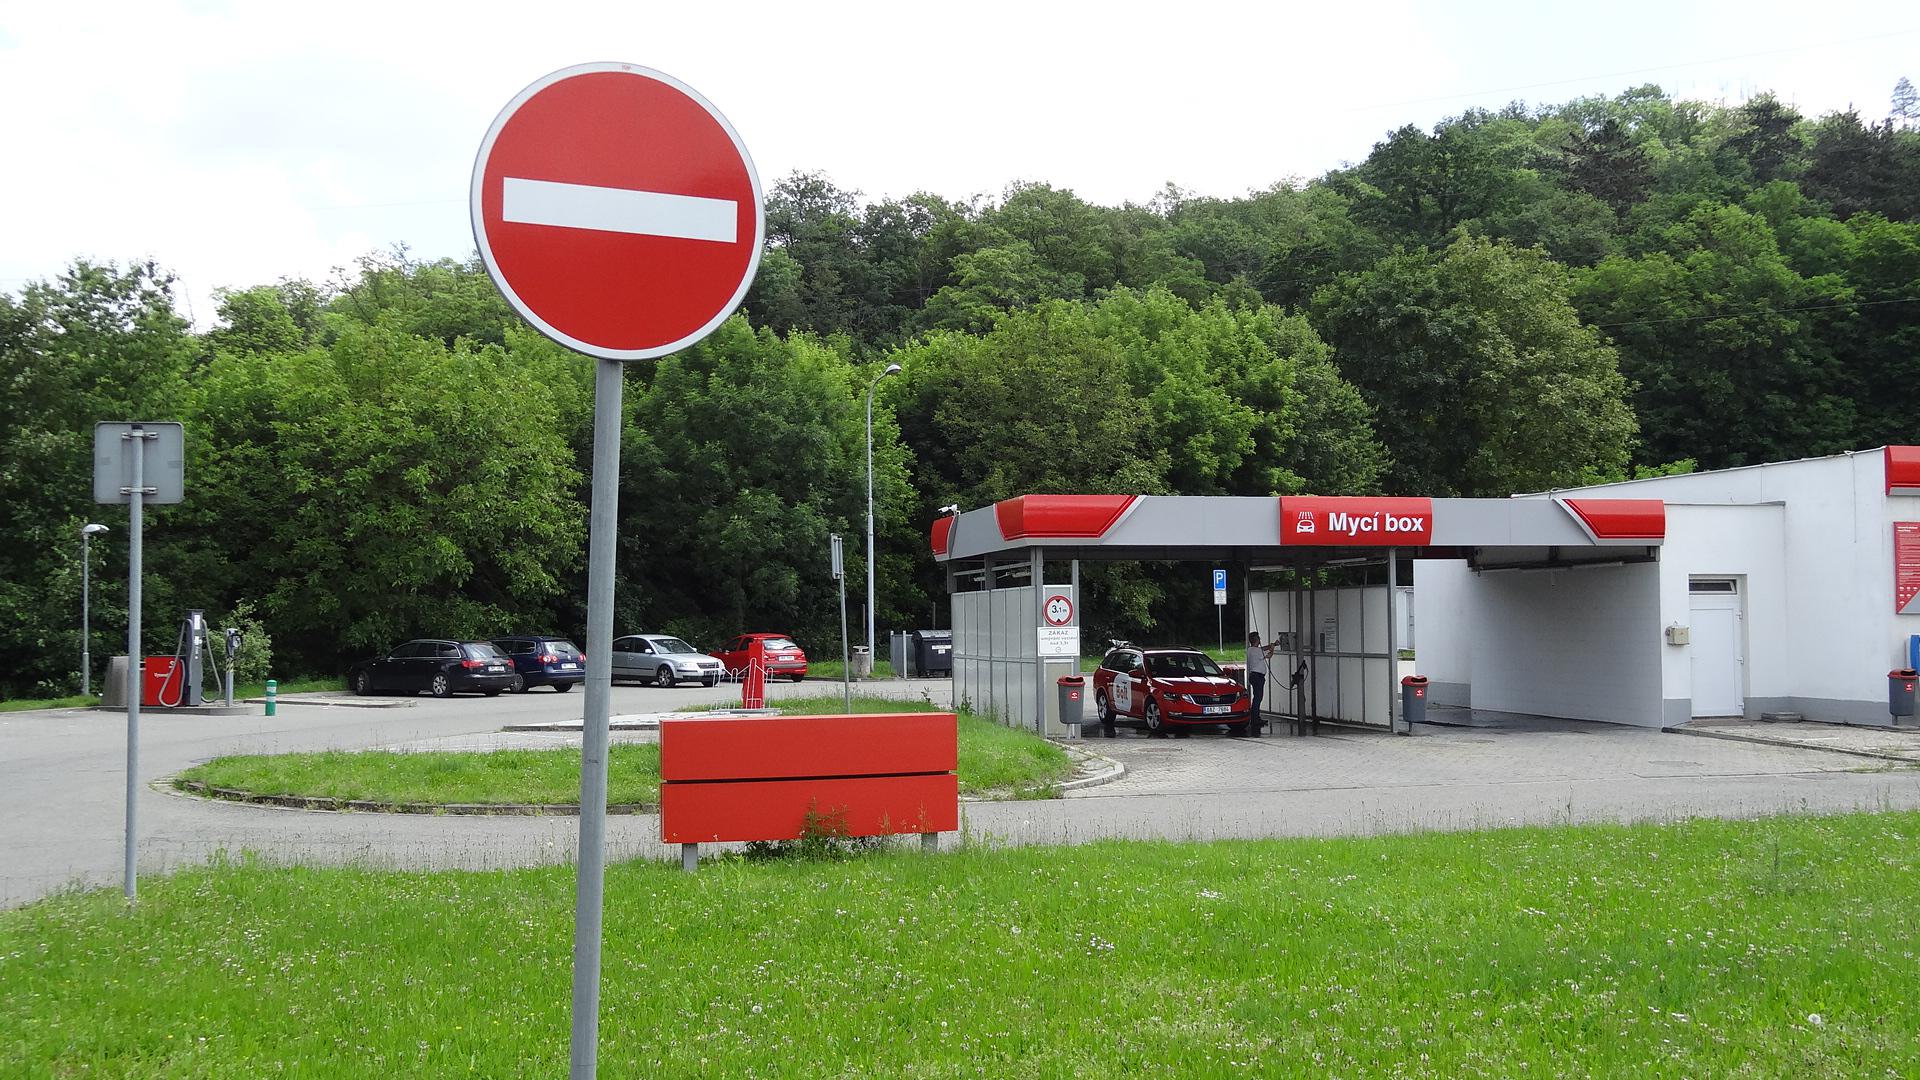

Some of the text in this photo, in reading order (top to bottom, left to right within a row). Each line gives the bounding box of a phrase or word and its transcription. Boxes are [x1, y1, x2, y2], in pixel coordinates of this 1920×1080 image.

[1328, 512, 1424, 536] Mycí box
[1216, 573, 1223, 584] P
